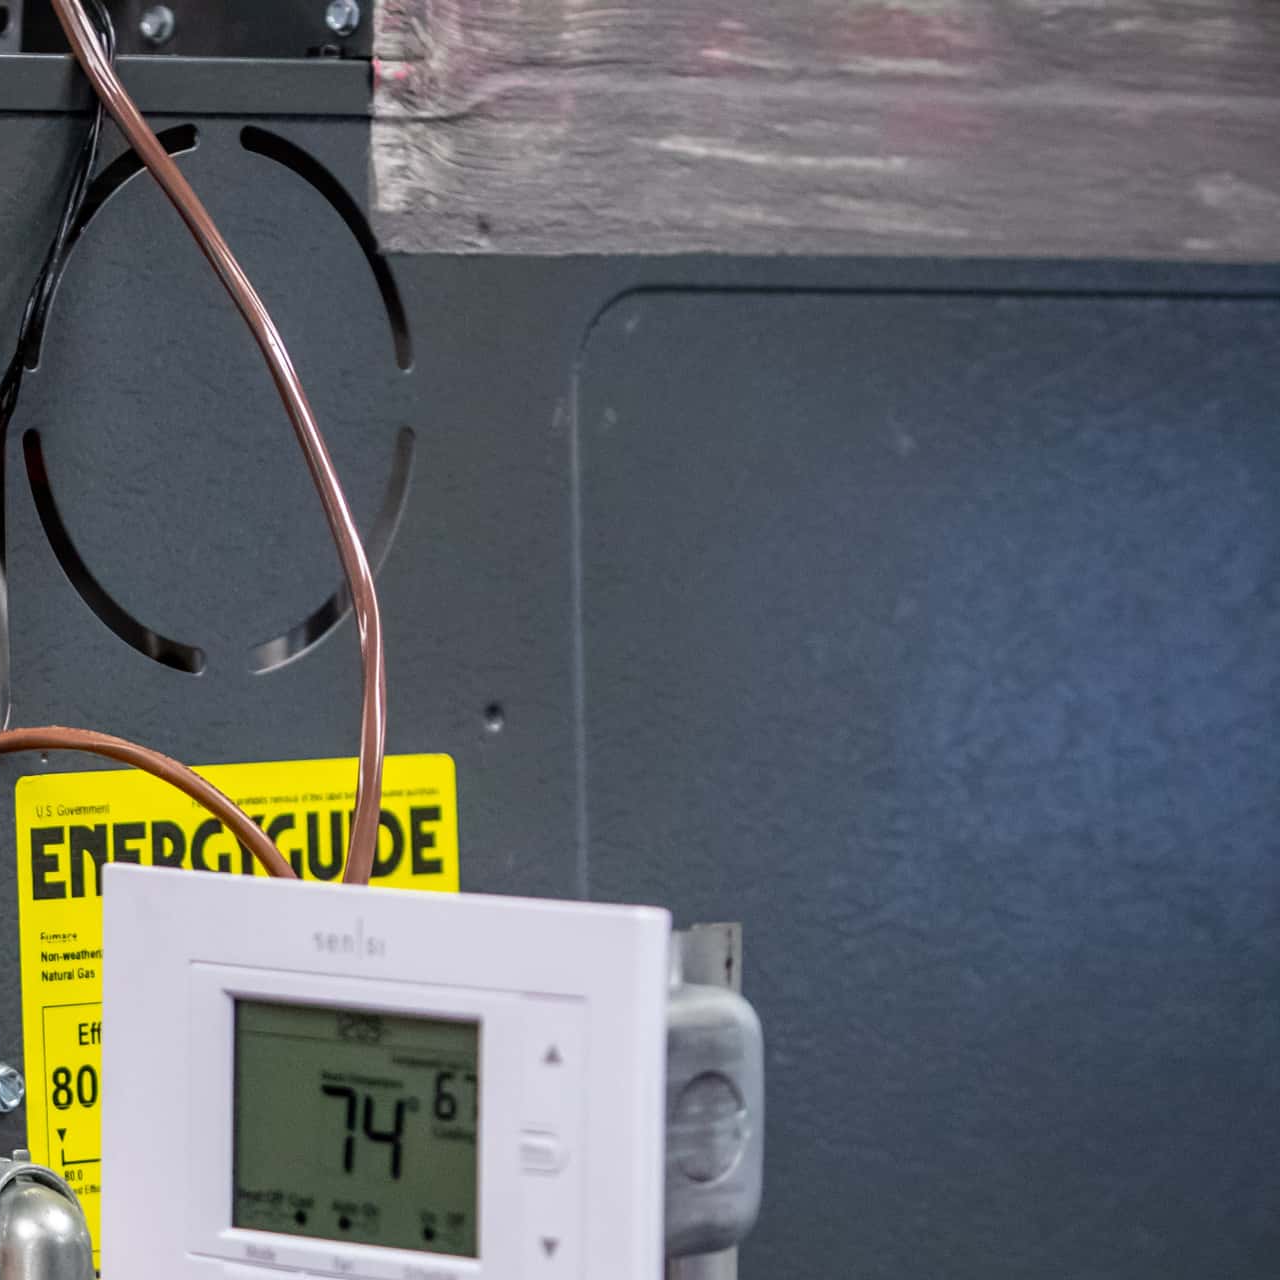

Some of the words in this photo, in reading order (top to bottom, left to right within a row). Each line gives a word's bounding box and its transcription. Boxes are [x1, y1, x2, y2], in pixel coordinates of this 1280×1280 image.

[57, 804, 110, 817] Government
[30, 805, 444, 900] ENERGGUDE
[41, 969, 75, 982] Natural
[77, 967, 96, 979] Gas
[52, 1064, 99, 1110] 80
